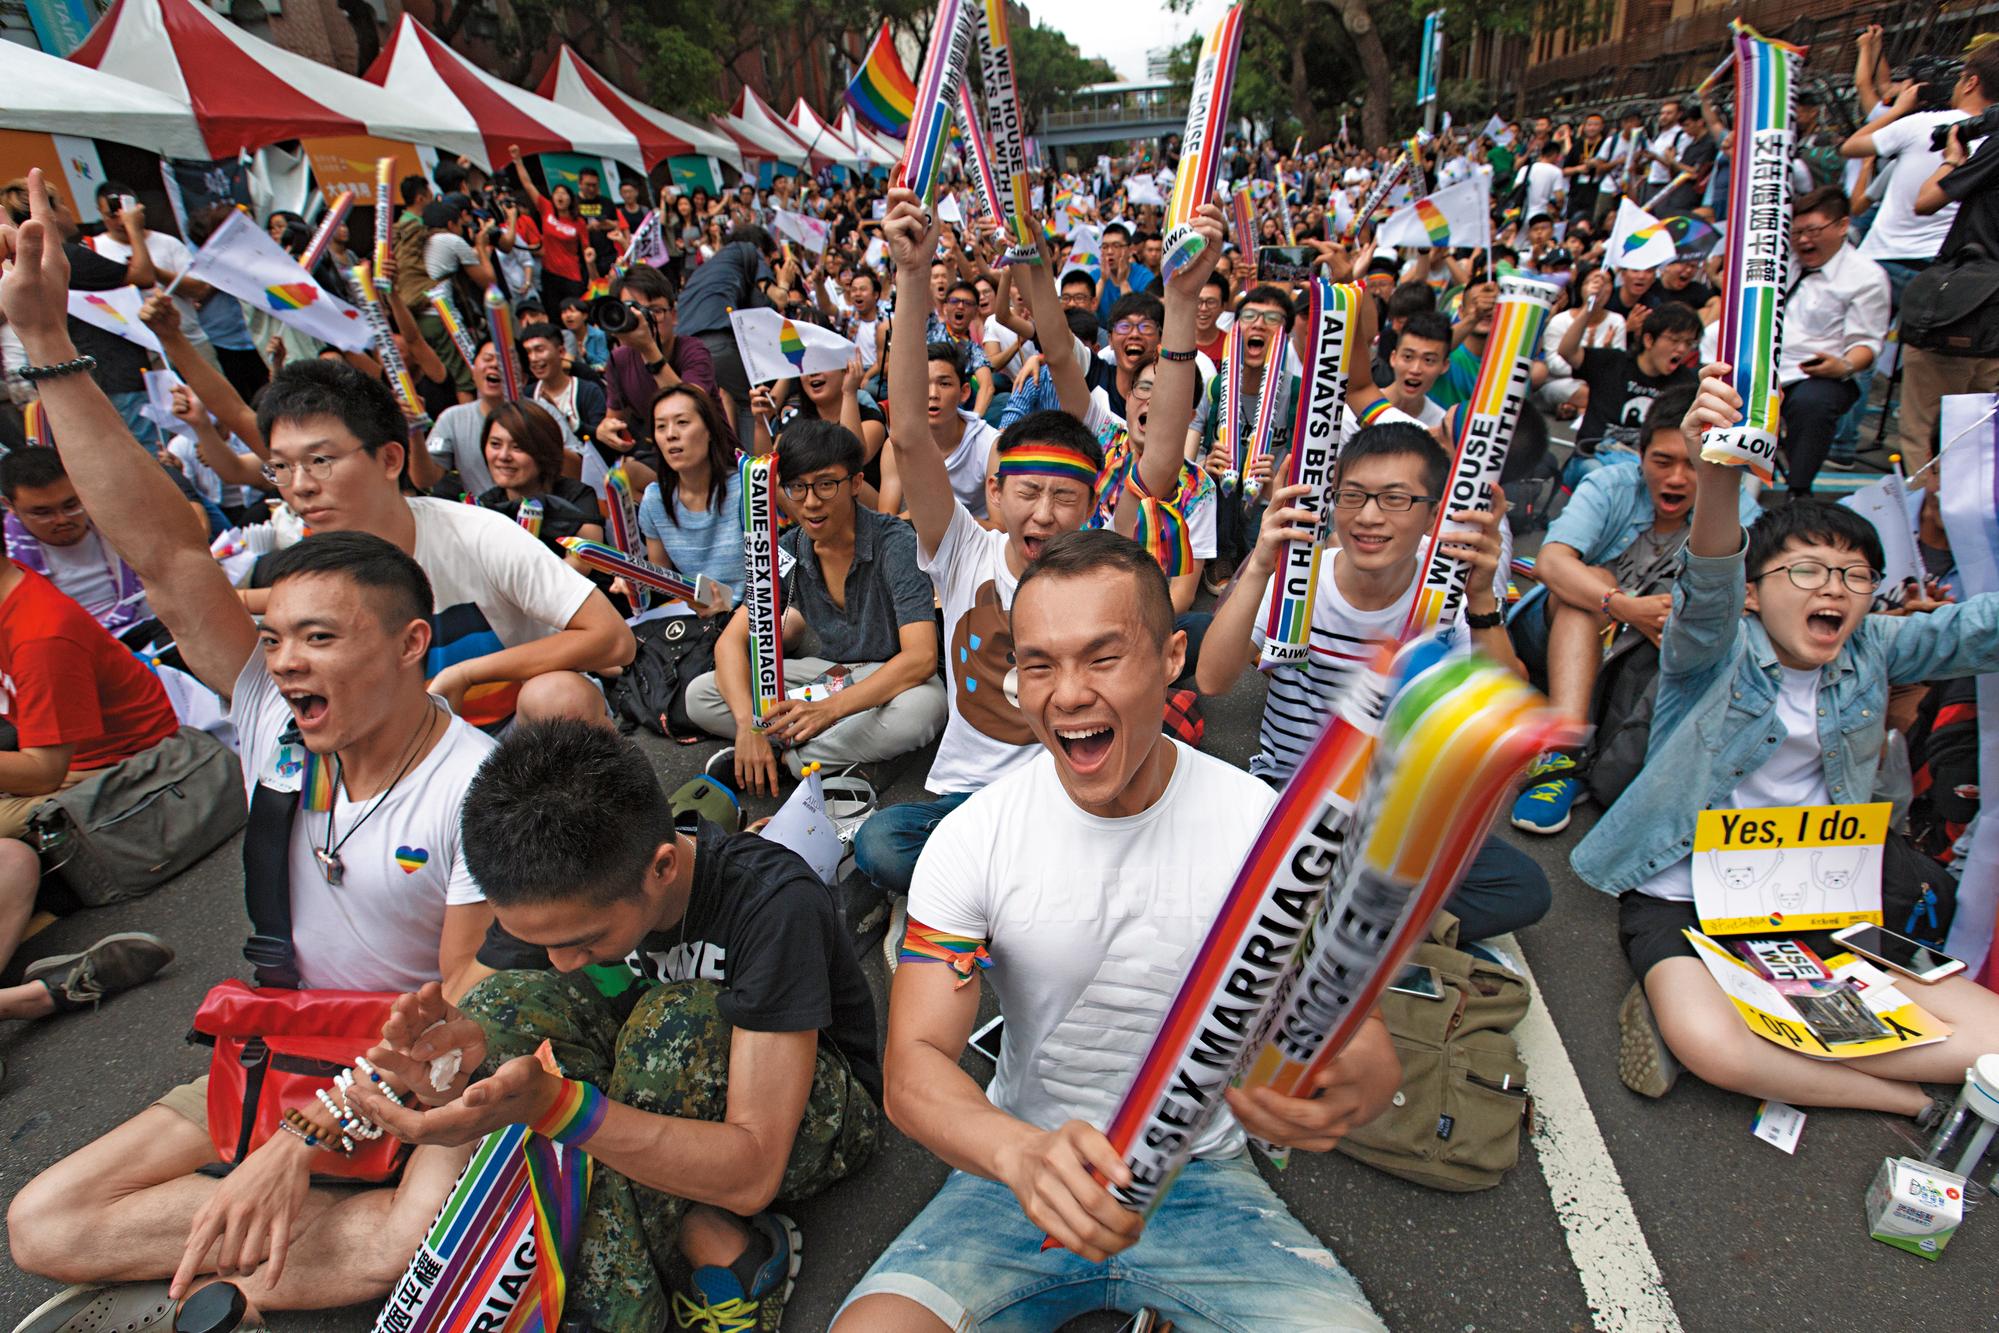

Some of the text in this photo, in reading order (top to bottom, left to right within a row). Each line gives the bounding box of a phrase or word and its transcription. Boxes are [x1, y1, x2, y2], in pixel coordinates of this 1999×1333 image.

[995, 140, 1012, 193] WITH
[1002, 98, 1024, 173] HOUSE
[966, 145, 992, 216] MARRIAGE
[1003, 200, 1015, 217] U
[1310, 316, 1344, 438] ALWAYS
[1486, 394, 1526, 472] WITH
[1513, 360, 1530, 383] U
[1303, 449, 1326, 487] BE
[1446, 419, 1495, 523] HOUSE
[752, 468, 776, 696] SAME-SEX MARRIAGE
[1288, 578, 1307, 596] U
[1721, 810, 1867, 848] Yes, I do.
[1190, 802, 1351, 1073] MARRIAGE
